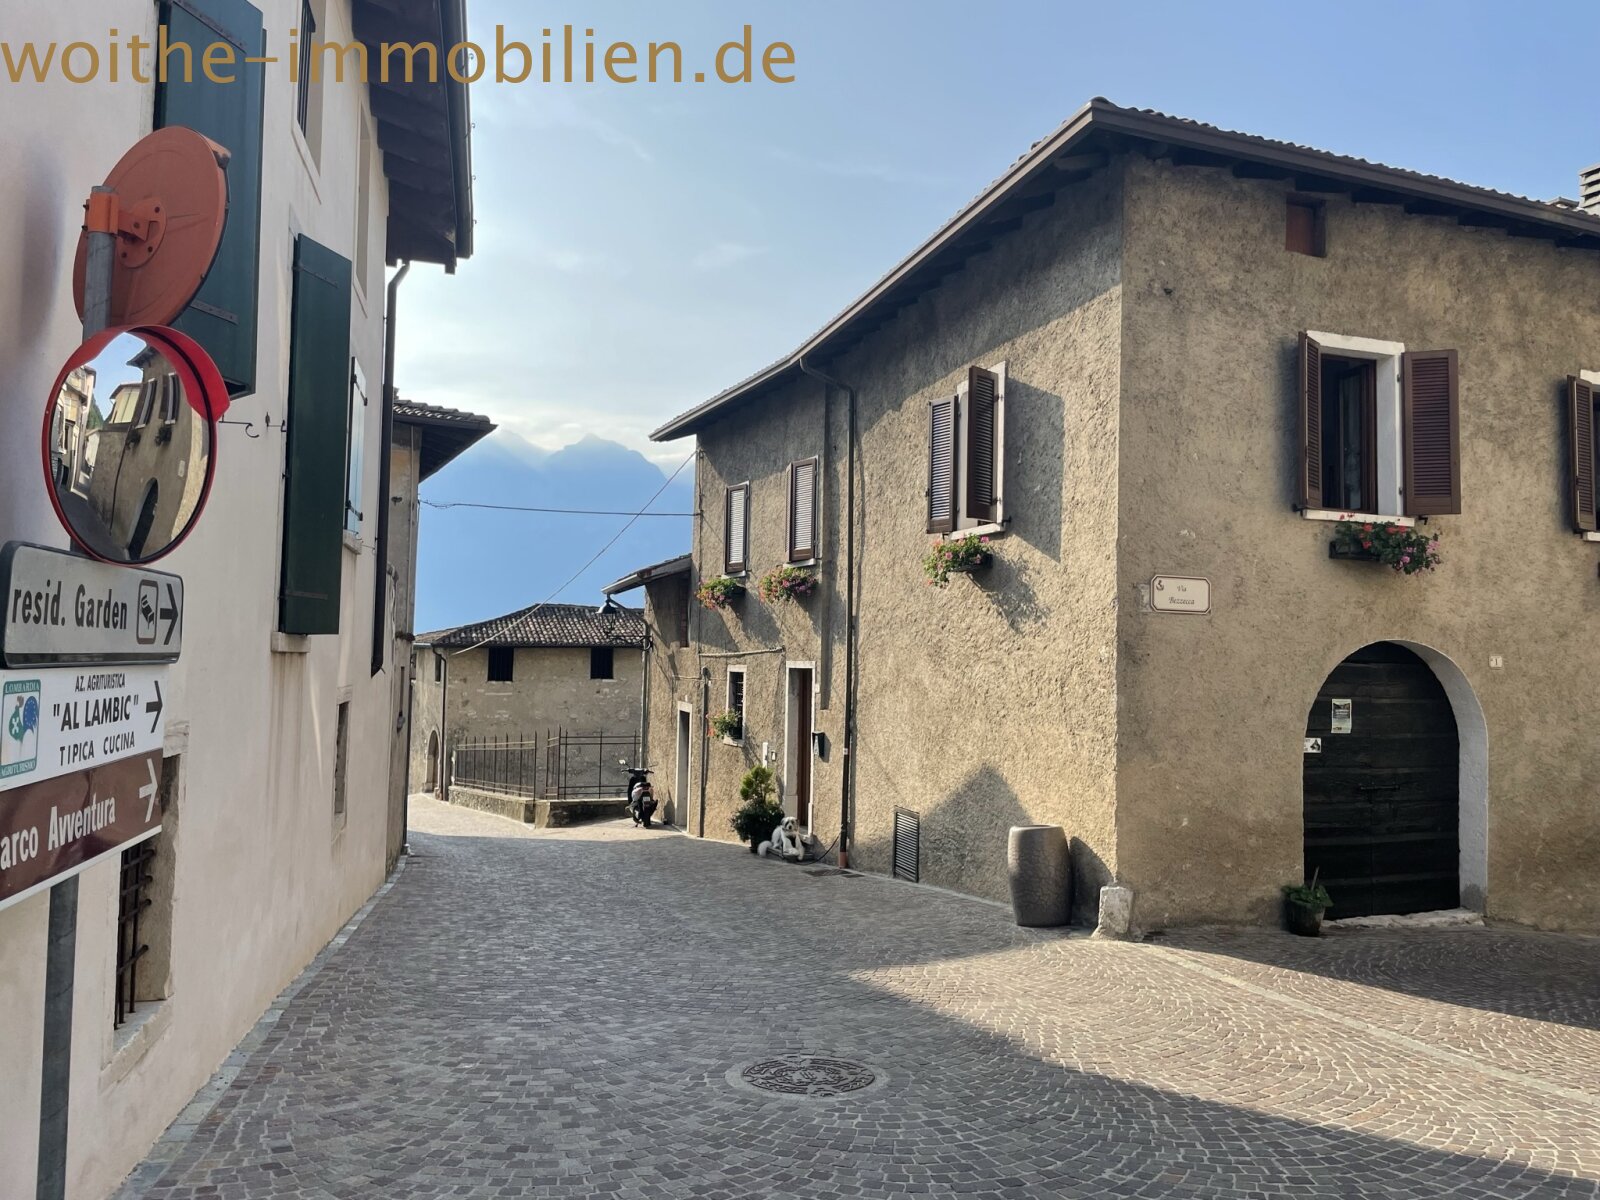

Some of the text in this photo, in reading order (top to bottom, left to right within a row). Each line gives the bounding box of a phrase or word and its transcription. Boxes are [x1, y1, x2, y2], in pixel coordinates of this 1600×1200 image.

[12, 579, 128, 630] resid. Garden
[5, 682, 40, 694] LOMBARDIA
[75, 673, 126, 692] AZ. AGRITURISTICA
[59, 731, 135, 767] TIPICA CUCINA
[48, 793, 116, 851] Avventura
